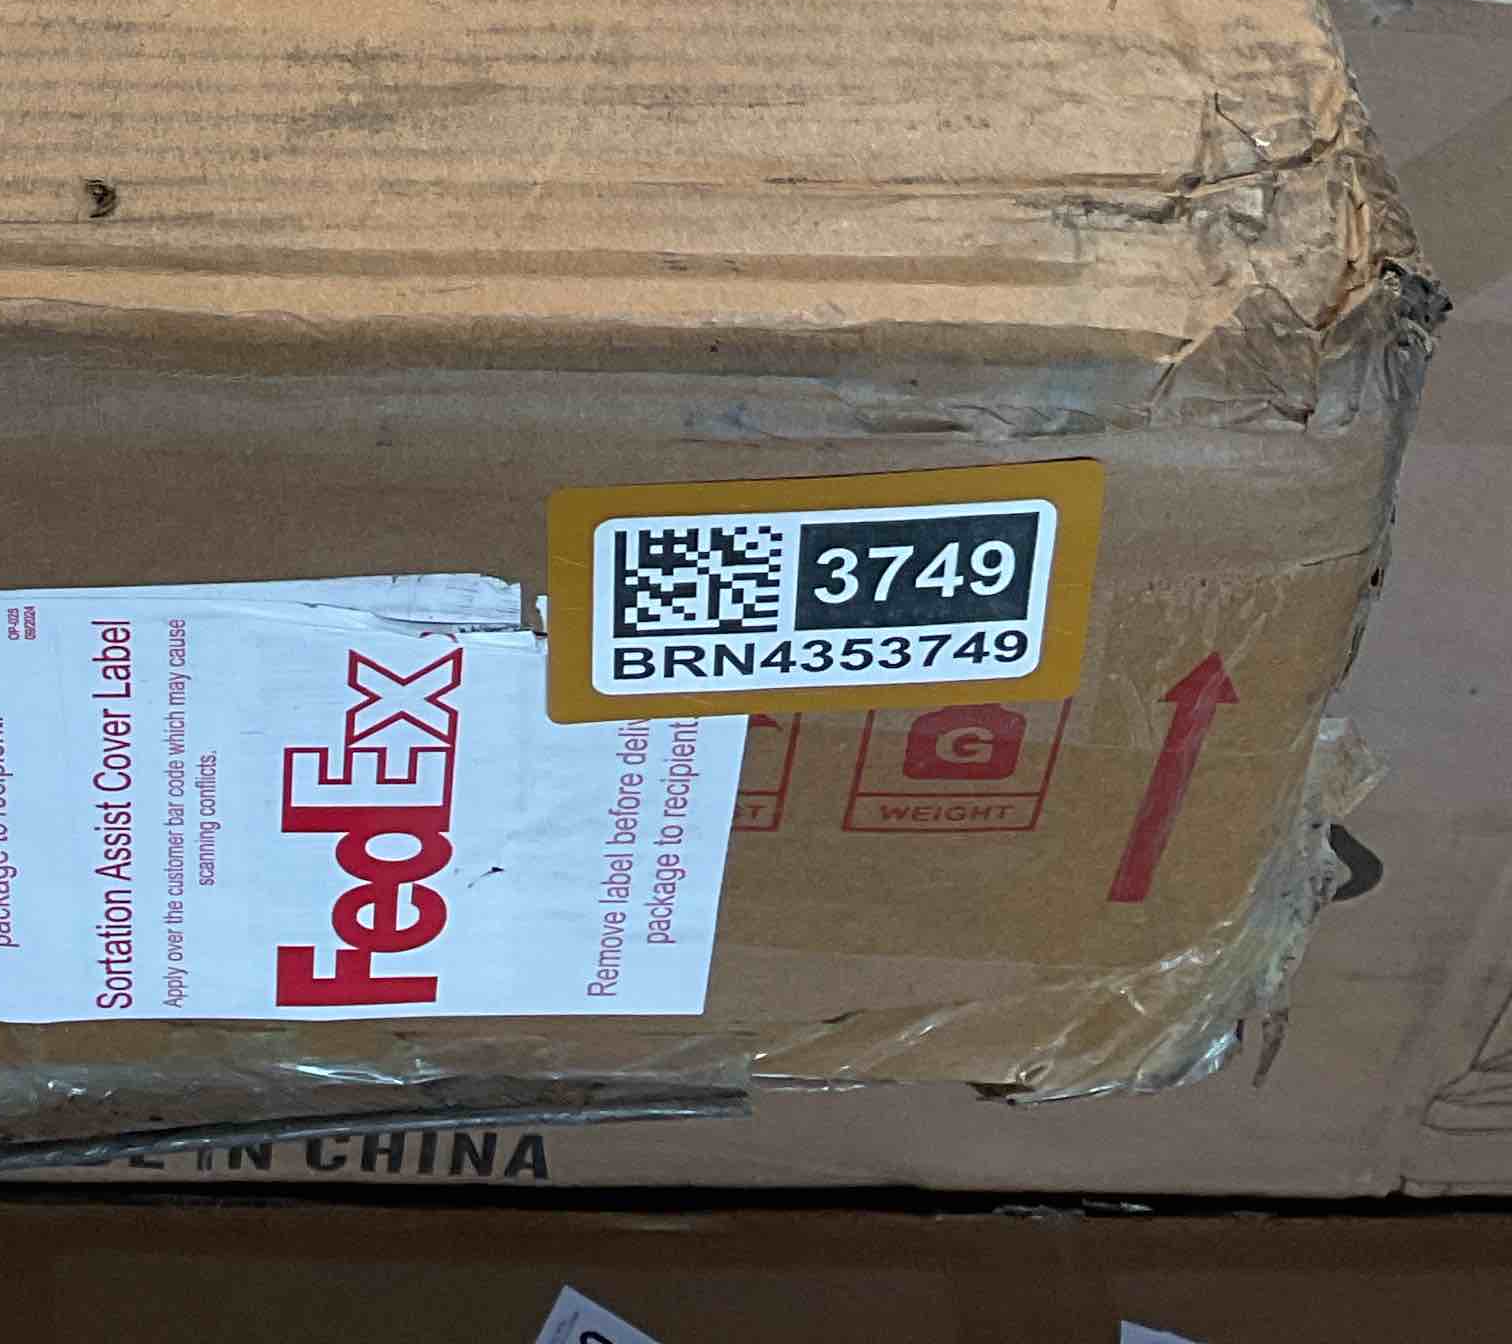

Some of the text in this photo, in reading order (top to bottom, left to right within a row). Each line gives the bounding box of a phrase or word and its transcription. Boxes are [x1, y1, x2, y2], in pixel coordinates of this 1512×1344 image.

[813, 540, 1017, 604] 3749
[613, 629, 1030, 682] BRN4353749
[92, 621, 132, 1009] Sortation Assist Cover Label
[163, 619, 191, 1008] Apply over the customer bar code which may cause
[195, 750, 222, 886] scanning conflicts.
[276, 648, 463, 1007] FedEx
[607, 772, 644, 847] before
[649, 825, 684, 852] to
[879, 804, 1016, 823] WEIGHT
[605, 852, 634, 906] label
[643, 854, 686, 944] package
[588, 911, 626, 997] Remove
[305, 1131, 551, 1180] CHINA
